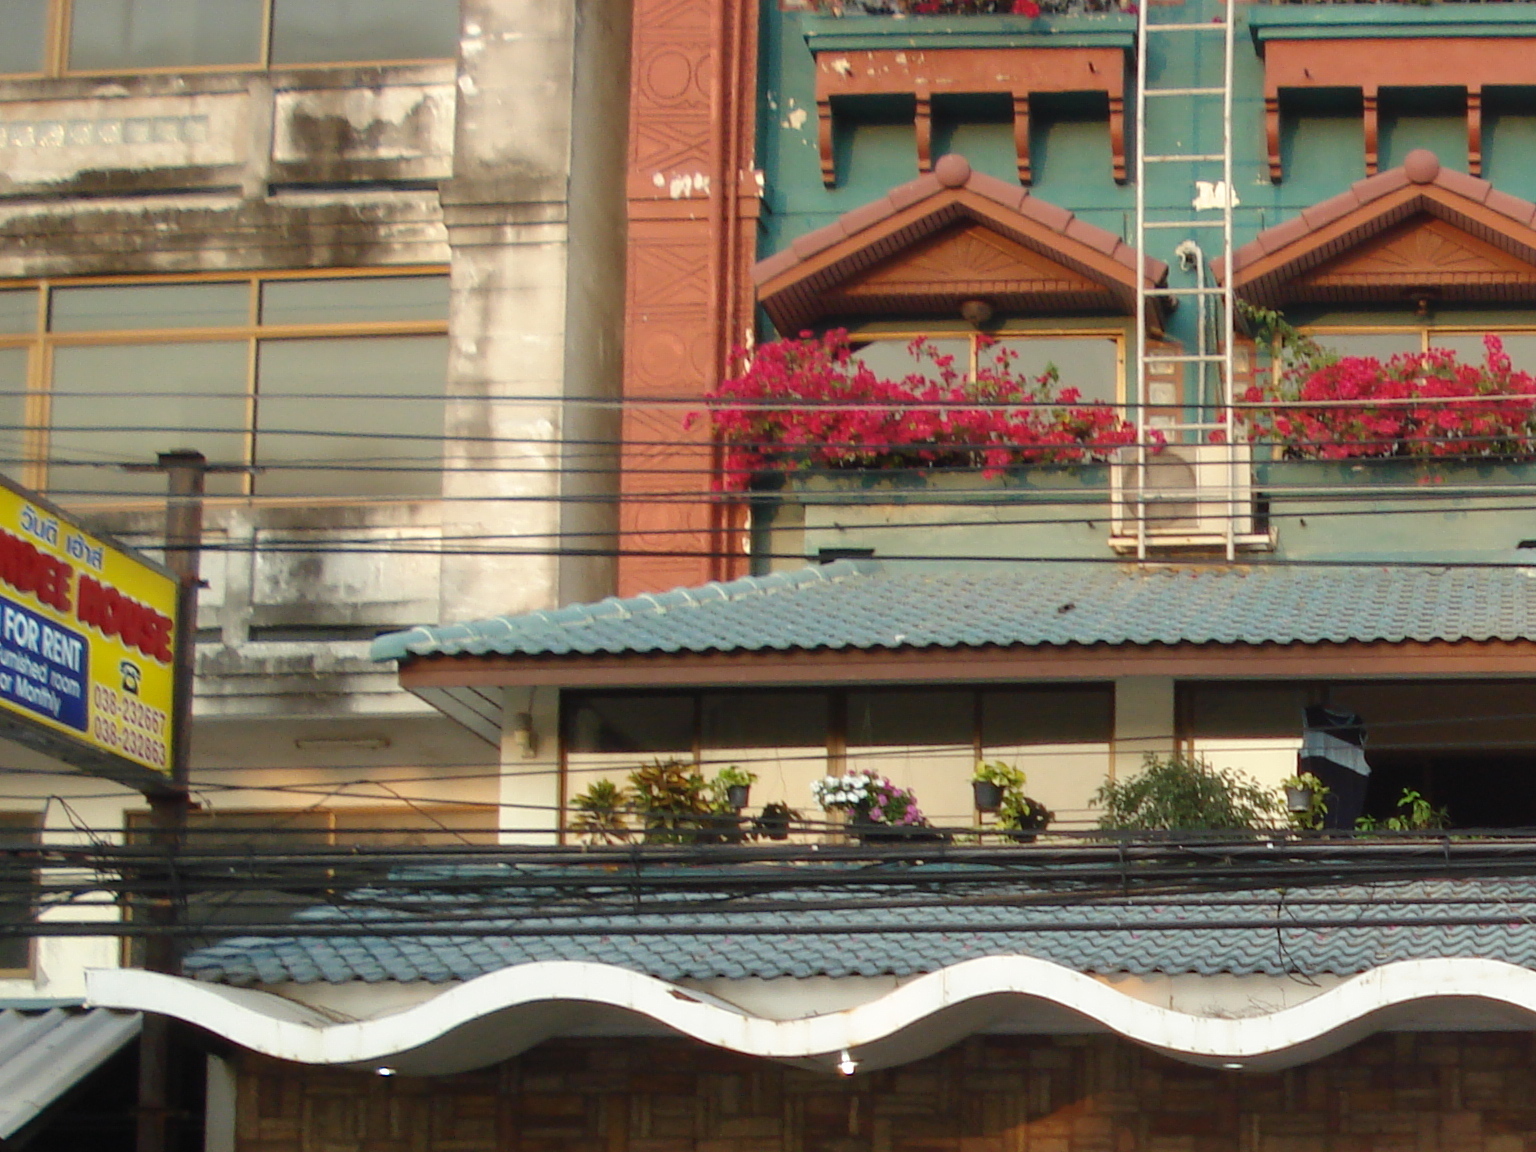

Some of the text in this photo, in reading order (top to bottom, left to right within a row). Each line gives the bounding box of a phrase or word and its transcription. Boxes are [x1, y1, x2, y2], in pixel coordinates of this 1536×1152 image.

[20, 505, 58, 546] วันดี
[4, 606, 82, 672] FOR RENT
[15, 674, 62, 718] Monthly
[50, 668, 81, 699] room
[94, 684, 167, 738] 038-232667
